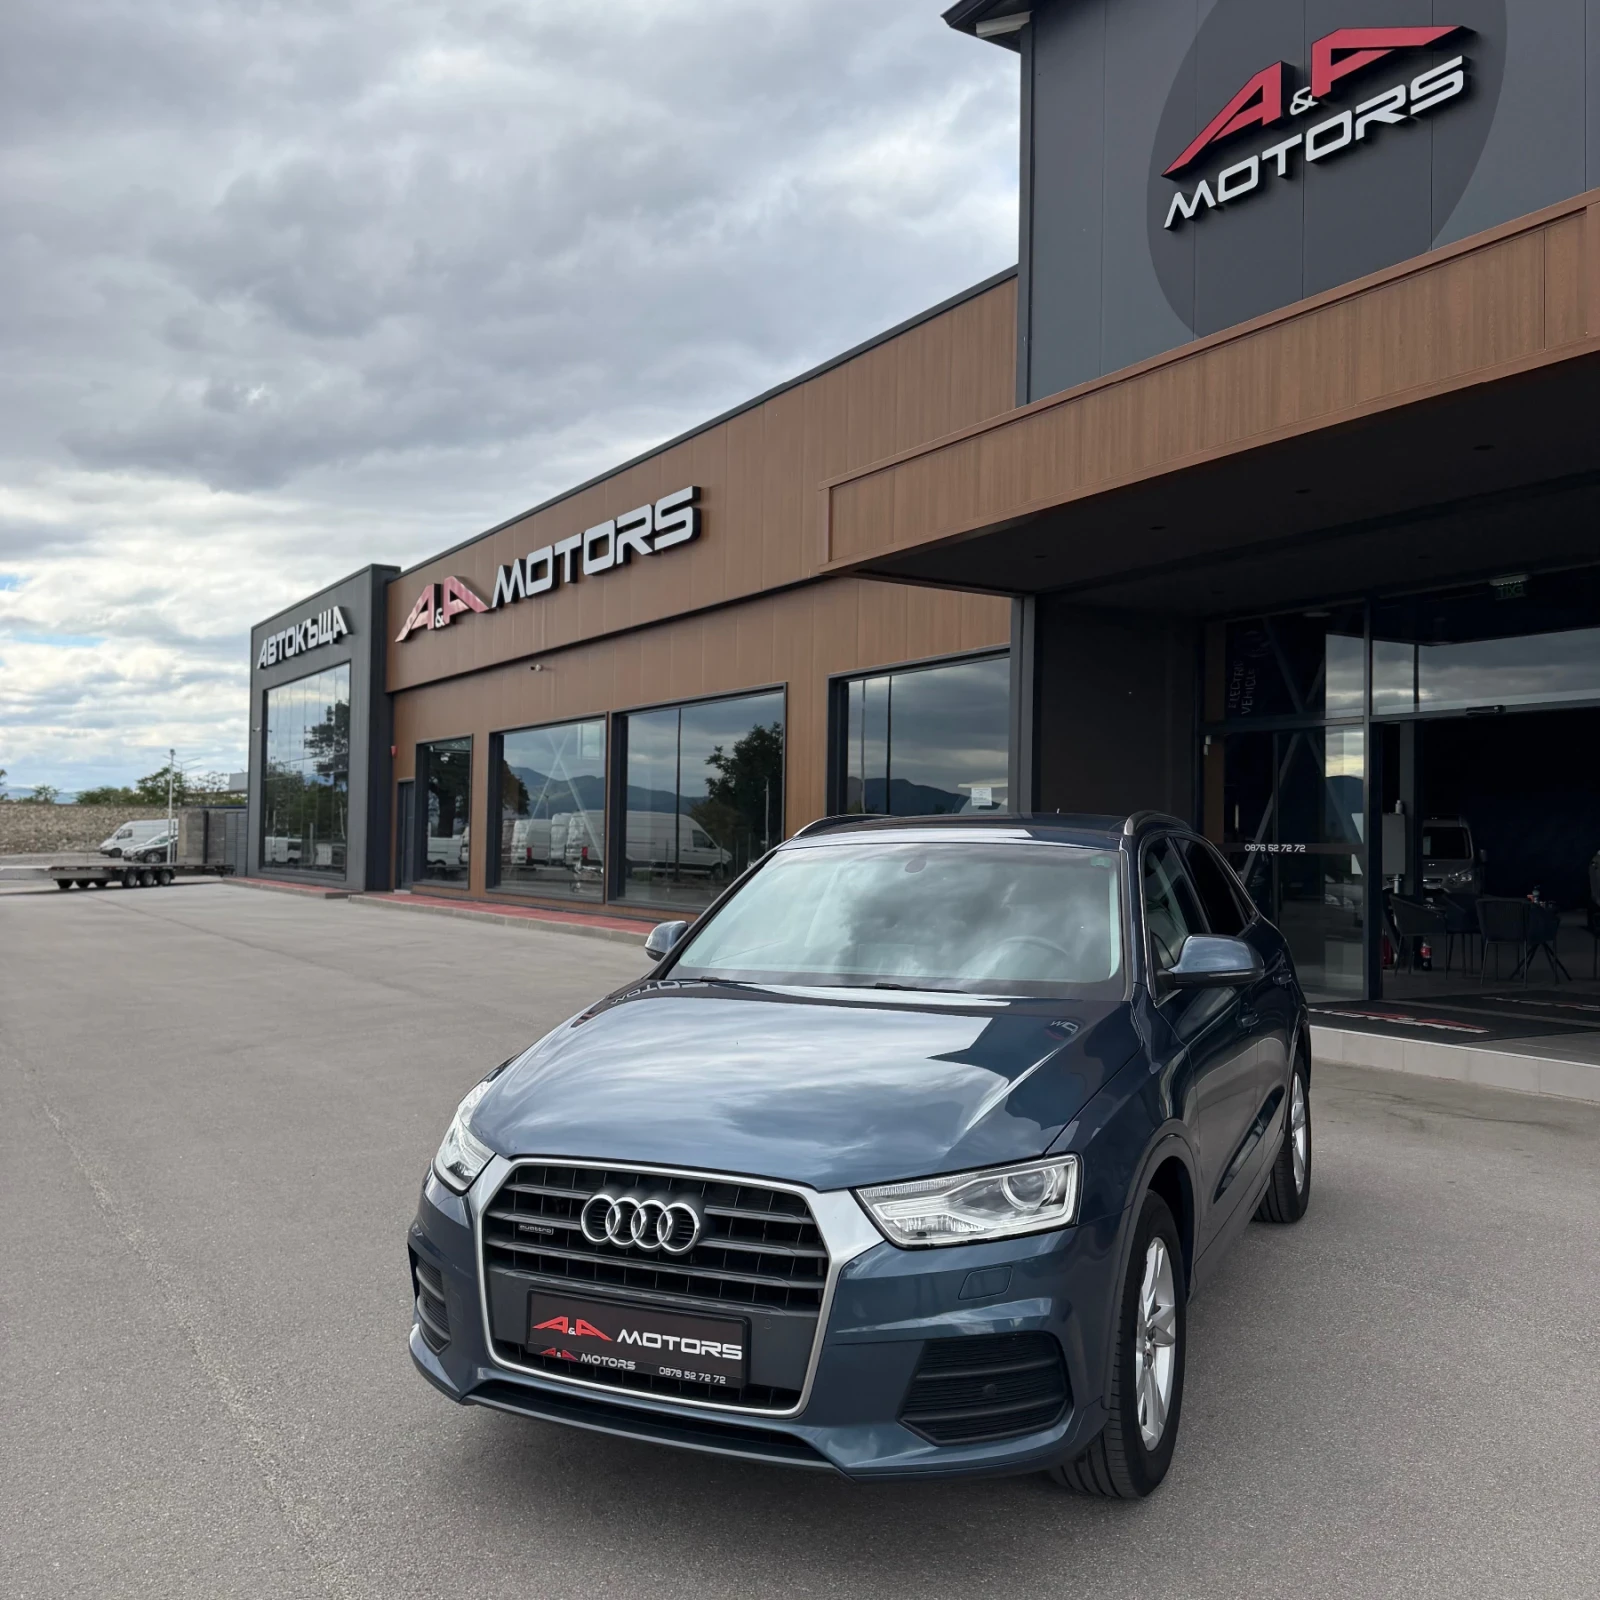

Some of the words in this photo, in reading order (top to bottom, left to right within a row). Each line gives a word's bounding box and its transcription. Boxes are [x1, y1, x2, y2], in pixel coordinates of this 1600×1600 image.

[1163, 55, 1465, 229] MOTORS
[492, 485, 699, 608] MOTORS
[256, 605, 348, 670] АВТОКЪЩА
[1244, 843, 1267, 852] 0876
[1267, 844, 1280, 853] 52
[1280, 844, 1293, 853] 72
[1293, 844, 1307, 854] 72
[533, 1316, 613, 1341] A&A
[617, 1329, 742, 1360] MOTORS
[580, 1353, 636, 1371] MOTORS
[684, 1370, 697, 1380] 52
[698, 1373, 711, 1382] 72
[713, 1375, 726, 1385] 72
